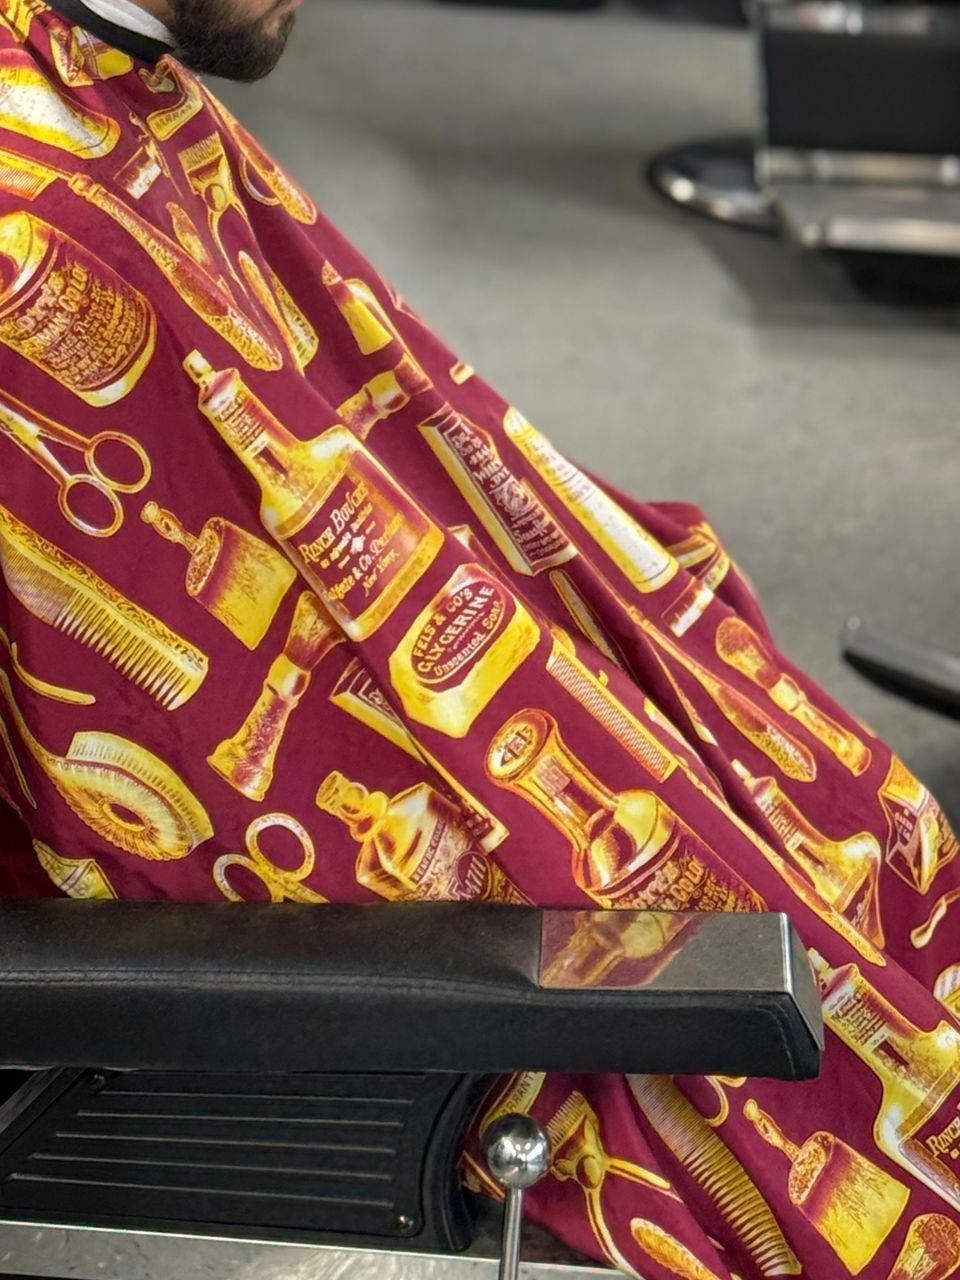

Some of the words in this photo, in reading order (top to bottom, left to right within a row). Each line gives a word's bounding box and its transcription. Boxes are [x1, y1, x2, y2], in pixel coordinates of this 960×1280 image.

[413, 624, 436, 658] FELS
[433, 612, 446, 626] &
[446, 588, 472, 613] CO'S
[417, 586, 494, 672] GLYCERINE
[433, 631, 486, 676] Unscented
